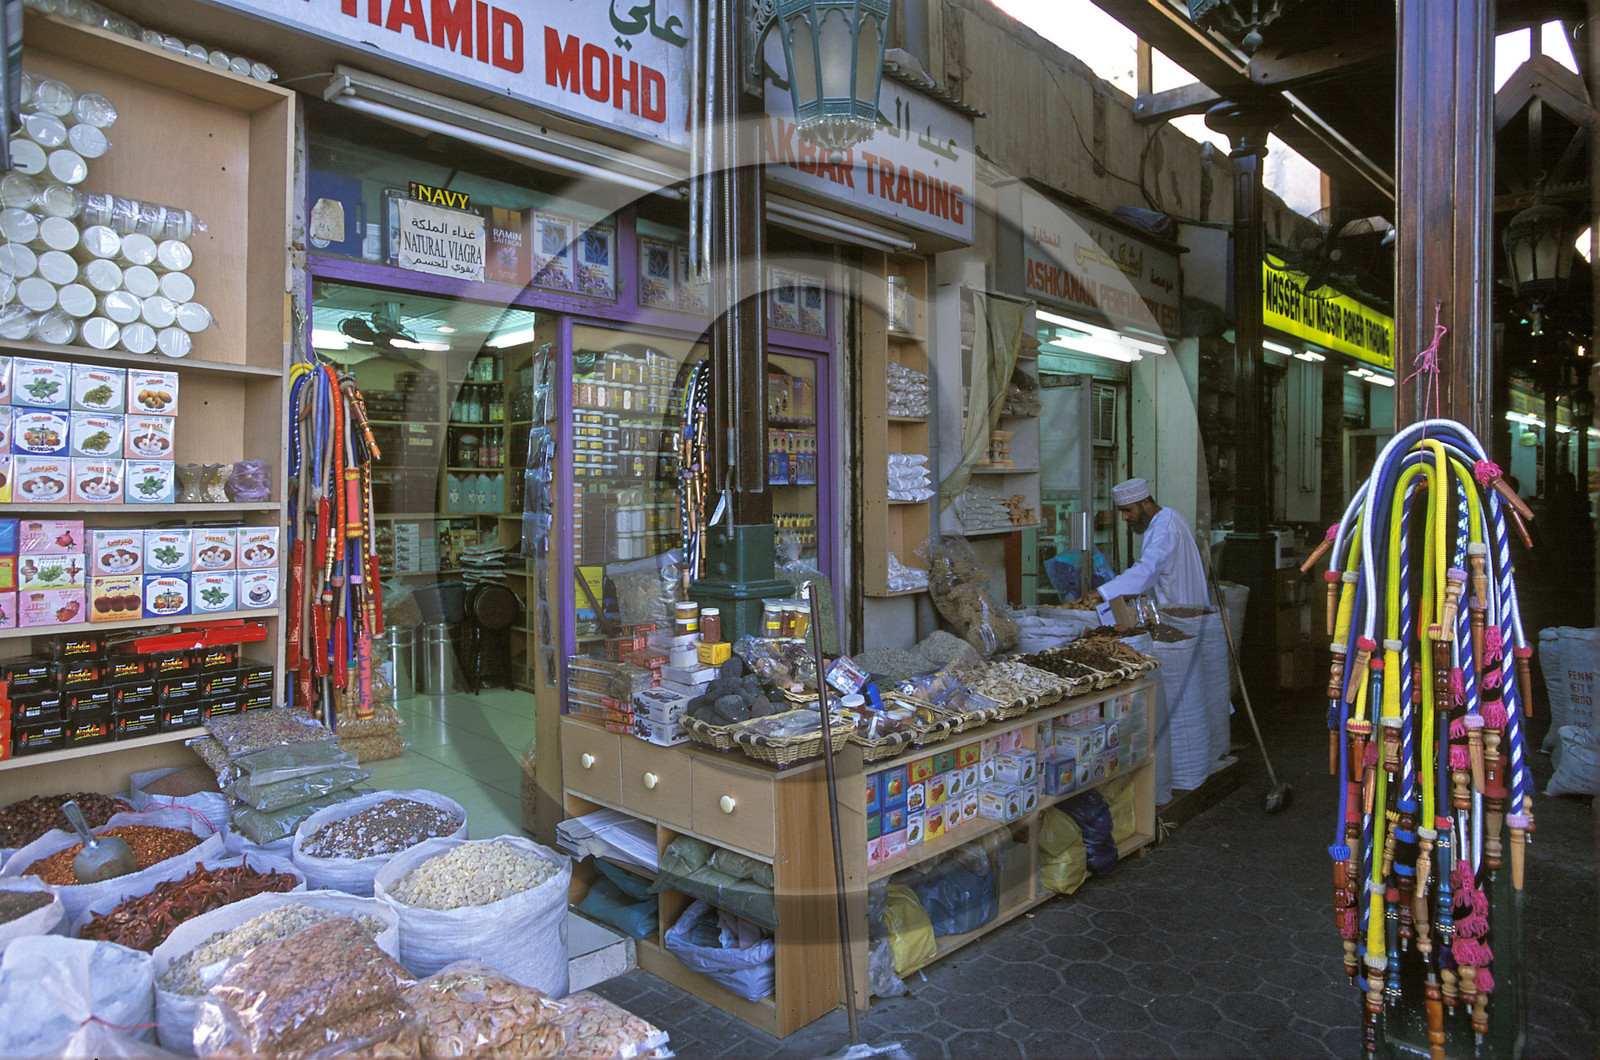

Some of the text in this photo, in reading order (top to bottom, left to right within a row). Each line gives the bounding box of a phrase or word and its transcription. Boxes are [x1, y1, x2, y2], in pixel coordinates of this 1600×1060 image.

[544, 25, 666, 123] MOHD
[418, 184, 469, 209] NAVY
[862, 151, 964, 225] TRADING
[412, 218, 475, 239] غذاء الملكة
[493, 228, 521, 241] RAMIN
[493, 237, 522, 247] SAFFRON
[403, 231, 482, 265] NATURAL VIAGRA
[1026, 257, 1097, 308] ASHKANANI
[1266, 269, 1301, 323] NASSER
